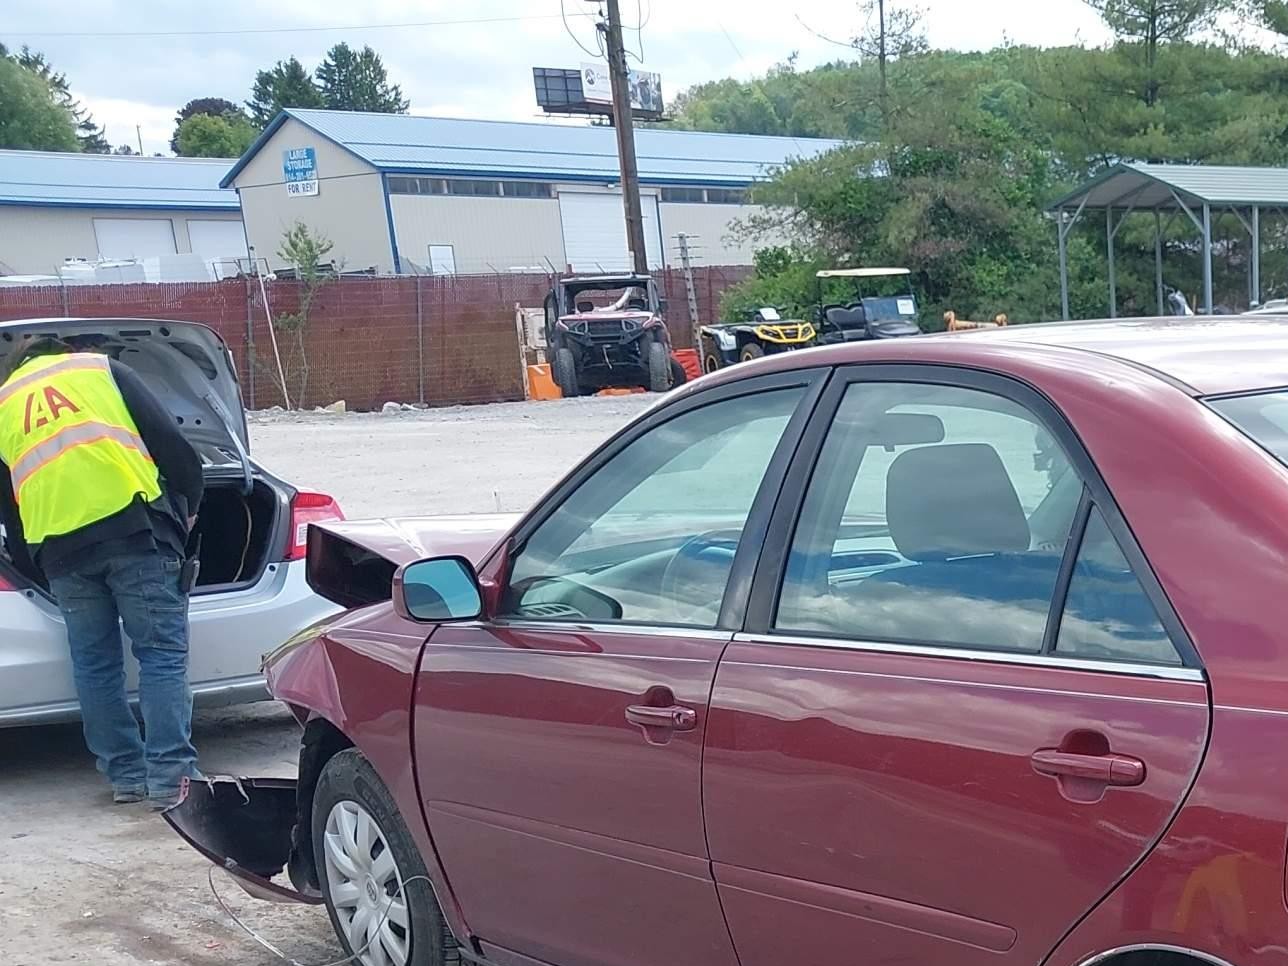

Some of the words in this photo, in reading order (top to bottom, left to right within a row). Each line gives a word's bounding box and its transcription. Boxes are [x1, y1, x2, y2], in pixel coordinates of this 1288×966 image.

[289, 149, 307, 159] LARGE
[287, 159, 313, 170] STORAGE
[288, 183, 300, 193] FOR
[302, 181, 317, 192] RENT
